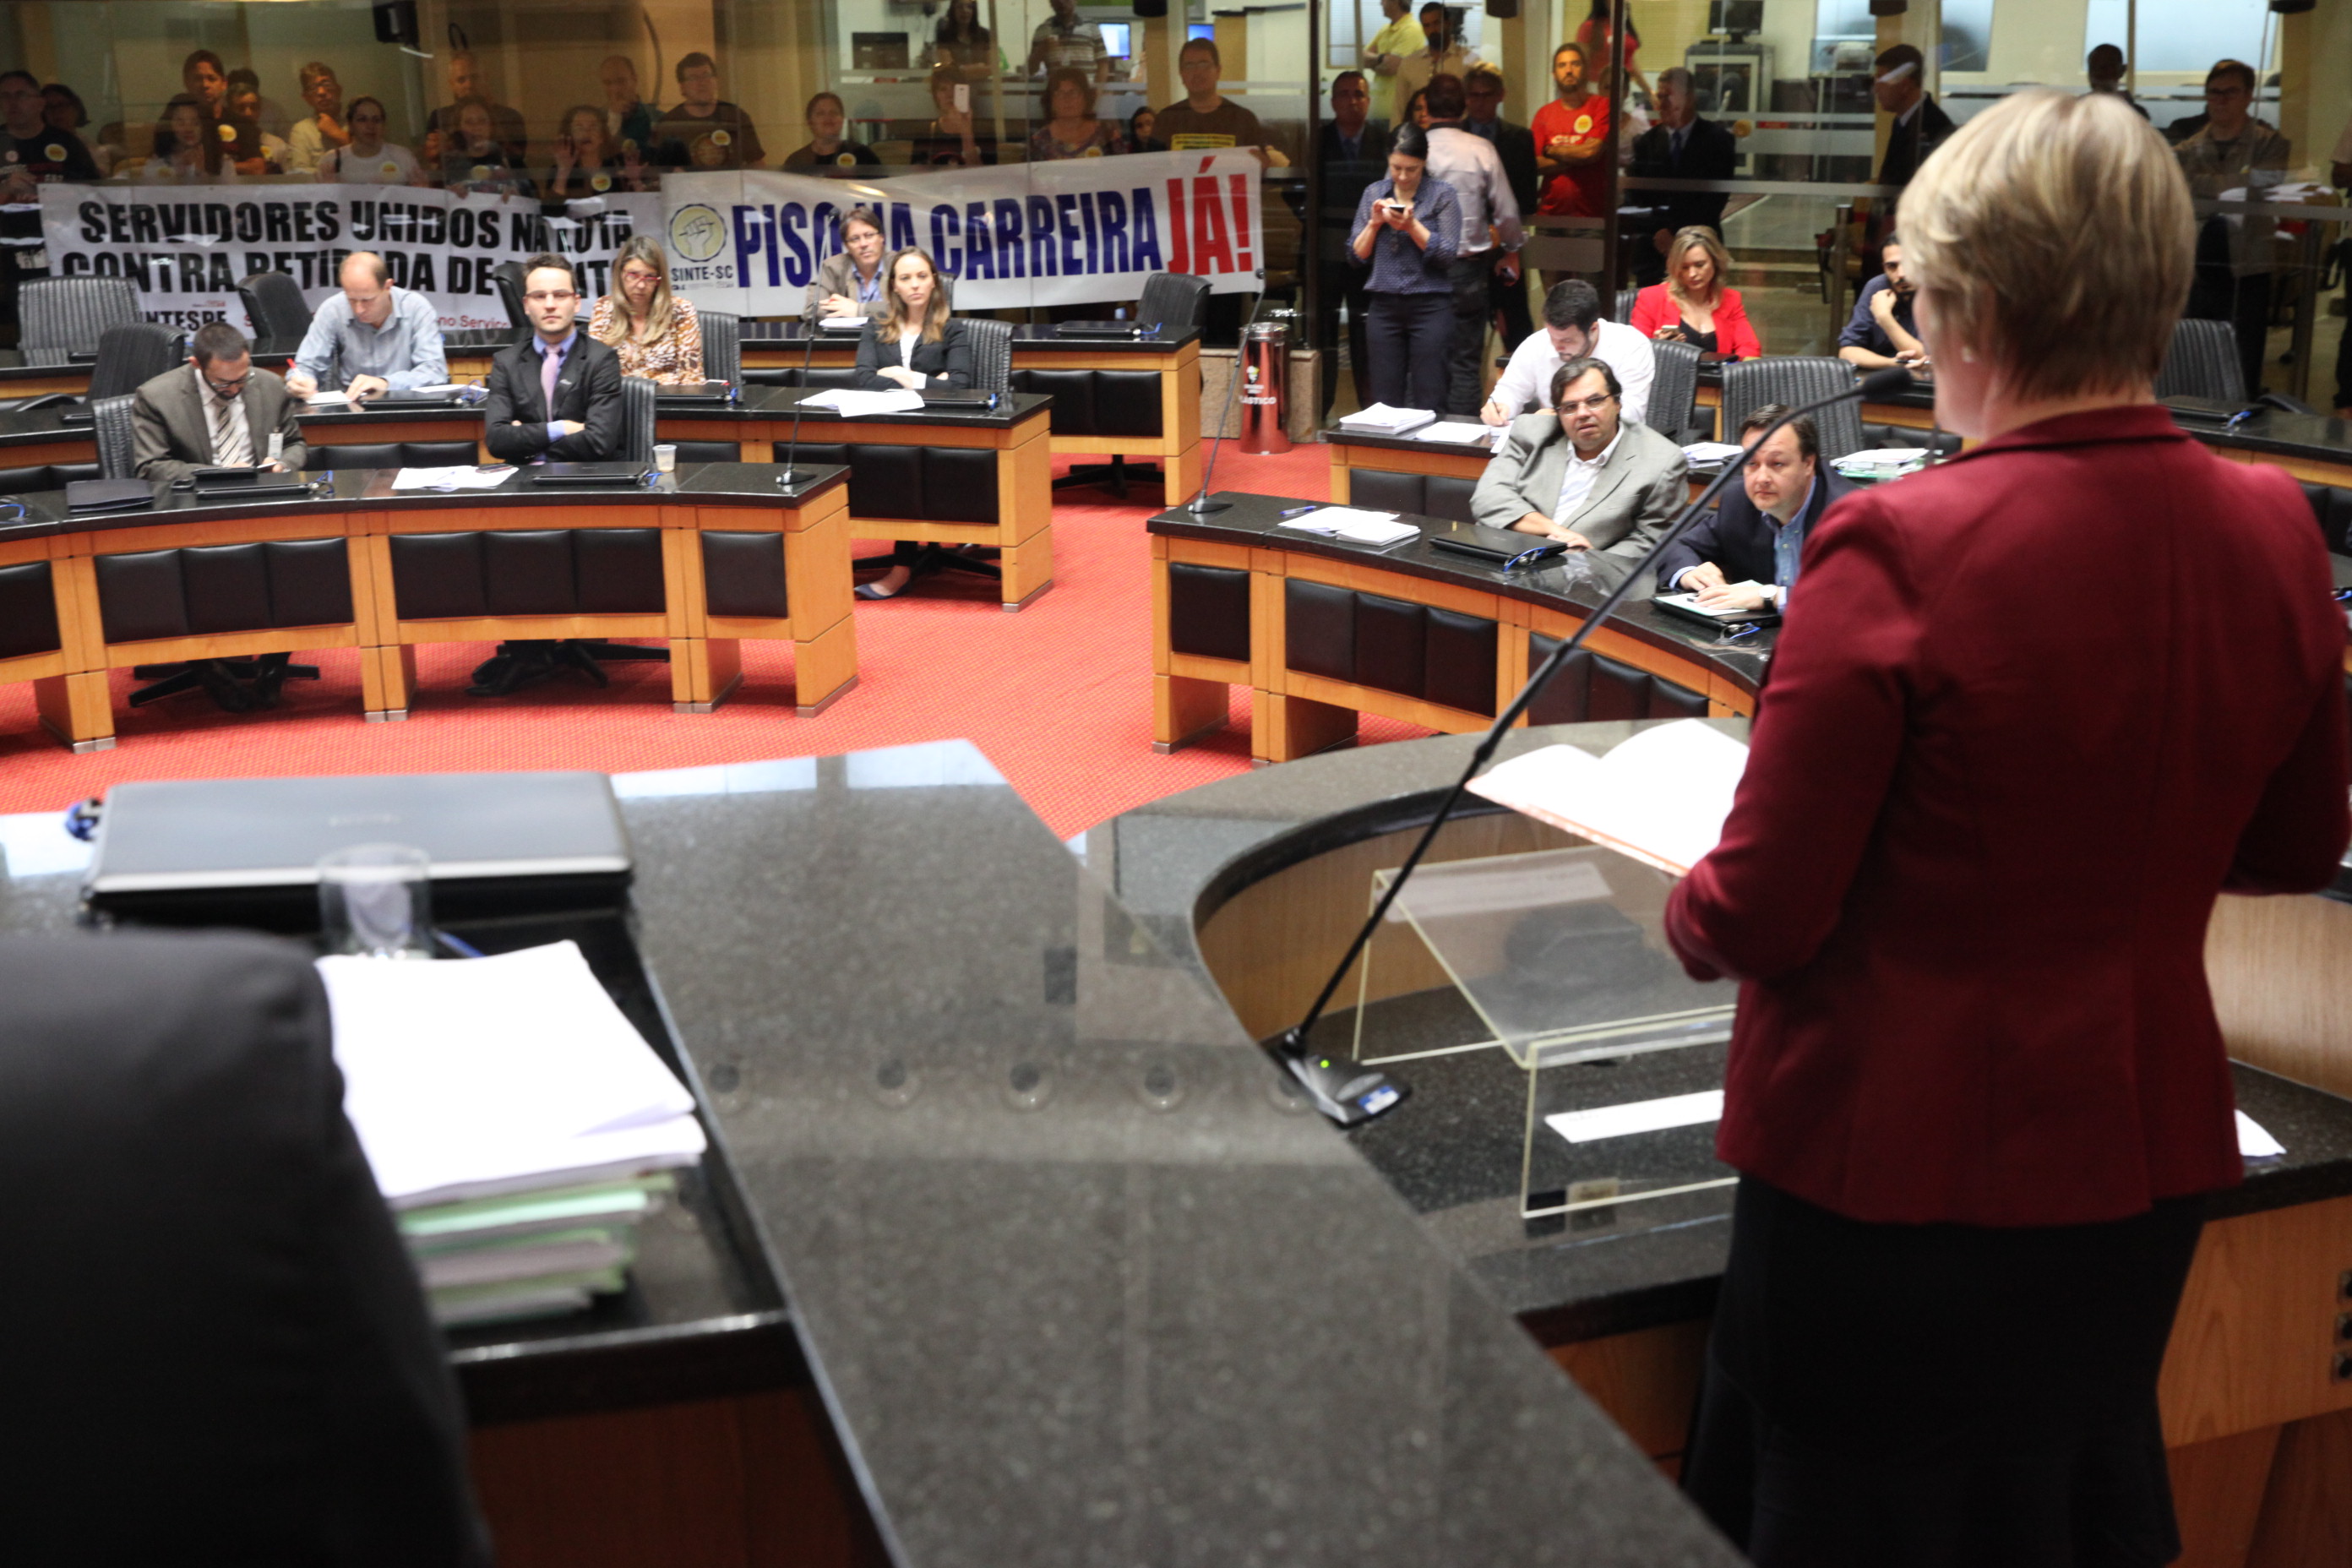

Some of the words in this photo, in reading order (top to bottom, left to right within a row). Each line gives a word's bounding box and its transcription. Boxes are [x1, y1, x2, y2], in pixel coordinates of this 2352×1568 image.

[78, 200, 340, 243] SERVIDORES
[351, 200, 500, 249] UNIDOS
[511, 212, 550, 253] NA
[732, 201, 843, 288] PISO
[930, 187, 1163, 280] CARREIRA
[1167, 155, 1253, 276] JÁ!
[63, 251, 237, 293] CONTRA
[447, 255, 494, 297] DE
[671, 264, 733, 281] SINTE-SC
